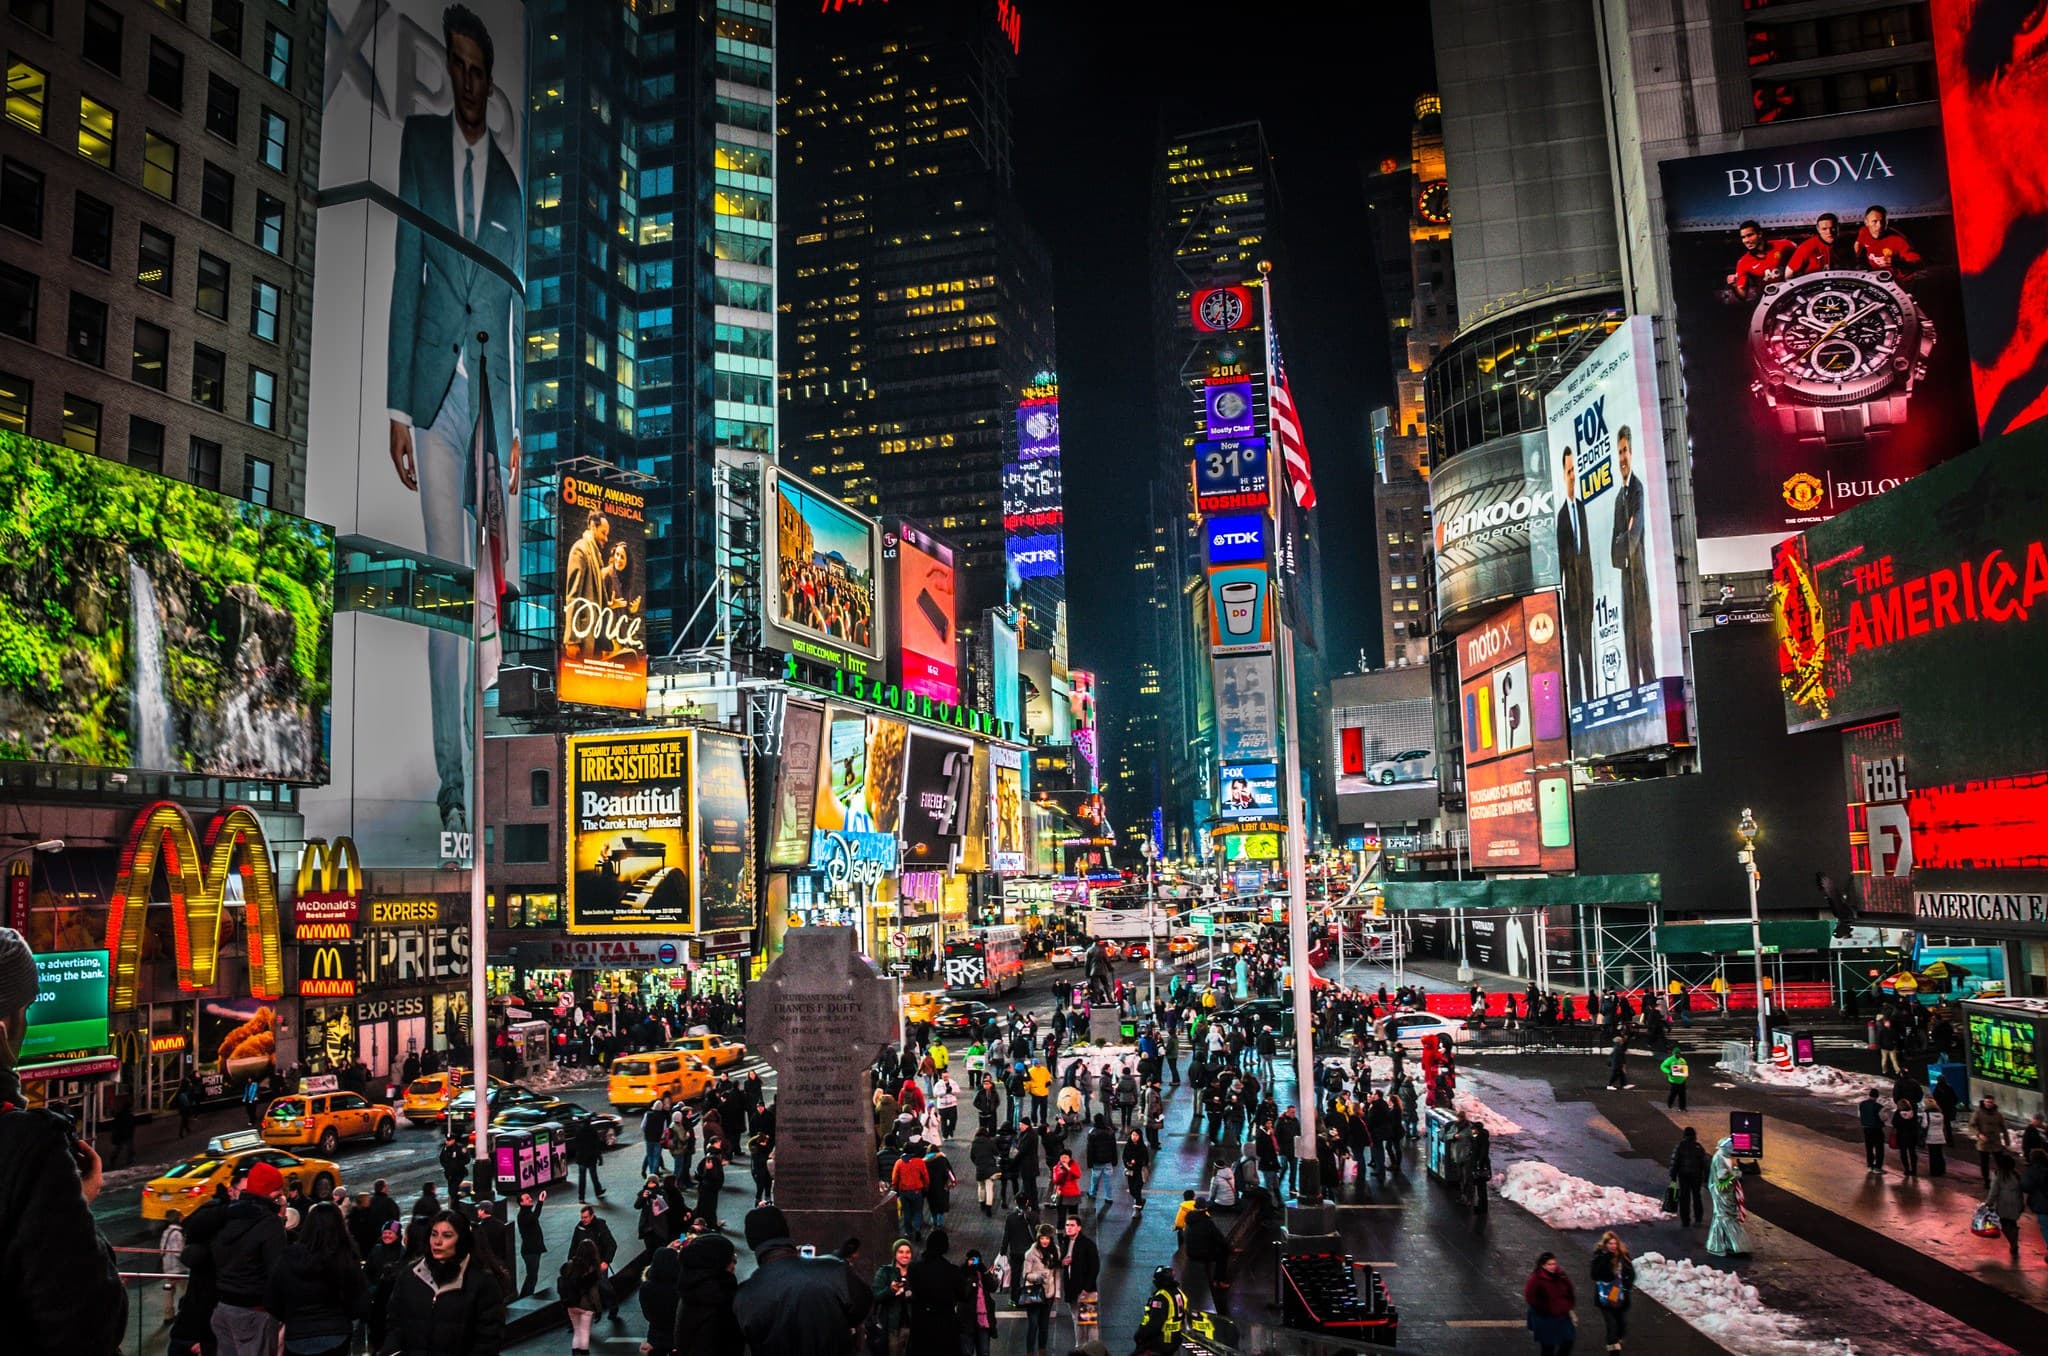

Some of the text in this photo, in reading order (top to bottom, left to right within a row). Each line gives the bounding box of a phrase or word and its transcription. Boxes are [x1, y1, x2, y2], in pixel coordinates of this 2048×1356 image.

[1726, 151, 1895, 197] BULOVA
[1212, 364, 1242, 377] 2014
[1205, 374, 1250, 386] TOSHIBA
[1211, 427, 1232, 435] Mostly
[1574, 394, 1608, 456] FOX
[1221, 442, 1239, 450] Now
[1577, 436, 1611, 473] SPORTS
[1581, 462, 1612, 500] LIVE
[563, 476, 577, 504] 8
[577, 480, 603, 497] TONY
[605, 487, 644, 508] AWARDS
[577, 495, 602, 511] BEST
[605, 502, 644, 522] MUSICAL
[1199, 492, 1269, 510] TOSHIBA
[908, 531, 915, 543] LG
[1223, 531, 1259, 544] TDK
[1455, 516, 1554, 550] driving emotion
[883, 550, 897, 558] LG
[1853, 555, 1893, 594] THE
[1232, 609, 1247, 617] DD
[1595, 595, 1619, 627] 11 PM
[1600, 625, 1619, 639] NIGHTLY
[792, 639, 806, 652] VISIT
[1468, 620, 1512, 667] moto X
[1605, 653, 1616, 666] FOX
[834, 670, 1015, 739] 1540 BROADWAY
[629, 744, 639, 754] THE
[640, 743, 660, 754] RANKS
[661, 743, 668, 753] OF
[669, 742, 681, 753] THE
[1223, 768, 1244, 778] FOX
[1863, 757, 1898, 802] FEB
[921, 792, 943, 808] FOREVER
[1470, 786, 1500, 804] THOUSANDS
[1500, 784, 1509, 798] OF
[1524, 780, 1532, 794] TO
[582, 787, 681, 817] Beautiful
[1498, 800, 1513, 816] YOUR
[582, 816, 681, 831] The Carole King Musical
[296, 901, 356, 911] McDonald's
[373, 903, 438, 921] EXPRESS
[1918, 894, 2048, 922] AMERICAN E
[305, 911, 346, 919] Restaurant
[551, 942, 640, 954] DIGITAL
[48, 957, 100, 969] advertising,
[64, 971, 79, 980] the
[81, 969, 105, 979] bank.
[358, 997, 423, 1020] EXPESS
[774, 1003, 816, 1013] FRANCIS
[828, 1001, 863, 1013] DUFFY
